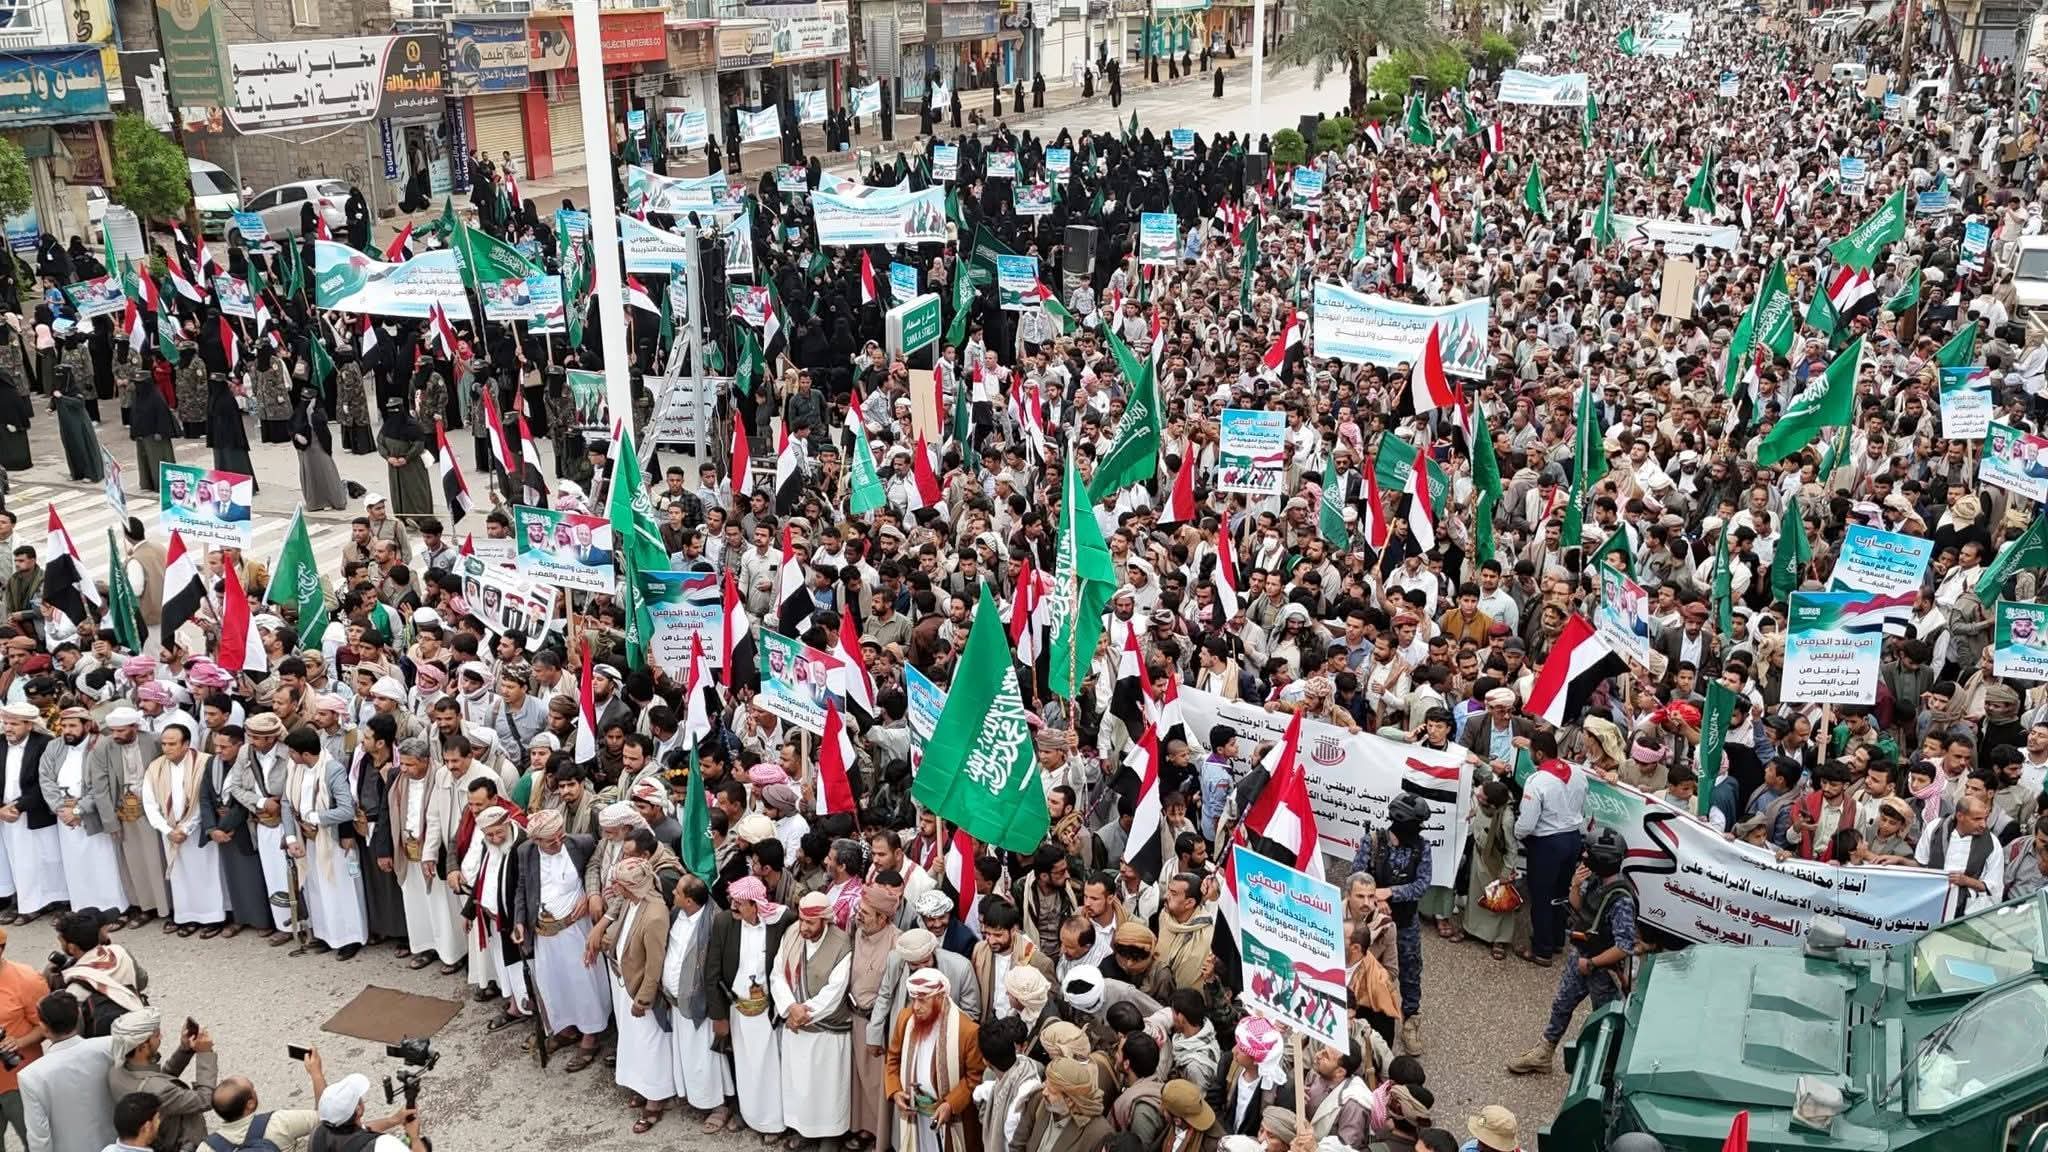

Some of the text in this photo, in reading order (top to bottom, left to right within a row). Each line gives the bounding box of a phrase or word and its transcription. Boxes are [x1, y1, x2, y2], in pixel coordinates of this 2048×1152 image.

[233, 51, 302, 84] اسطنبو
[305, 45, 376, 79] مخابز
[922, 323, 936, 339] STREET
[1795, 637, 1833, 647] الحرمين
[1834, 637, 1852, 646] بلاد
[1809, 649, 1854, 662] الشريفين
[1799, 666, 1812, 675] من
[1813, 665, 1840, 675] أصيل
[2004, 665, 2044, 675] والمصير
[1798, 677, 1836, 687] اليمن
[1795, 688, 1828, 698] العربي
[1216, 706, 1264, 729] الوطنية
[1304, 774, 1321, 785] الذي
[1320, 794, 1348, 810] وقوفنا
[1357, 788, 1390, 804] الجيش
[1349, 803, 1371, 814] نعلن
[1340, 816, 1360, 827] ضد
[1681, 862, 1704, 875] على
[1838, 874, 1867, 896] أبناء
[1247, 872, 1332, 915] الشعب اليمني
[1663, 876, 1721, 913] الشقيقة
[1249, 906, 1264, 917] التي
[1276, 905, 1307, 925] التدخلات
[1725, 900, 1801, 937] السعودية
[1813, 905, 1882, 930] ويستنكرون
[1255, 919, 1277, 935] العربية
[1264, 913, 1299, 932] الصهيونية
[1694, 914, 1753, 945] العربية
[1885, 917, 1930, 934] يدينون
[1278, 931, 1298, 944] الدول
